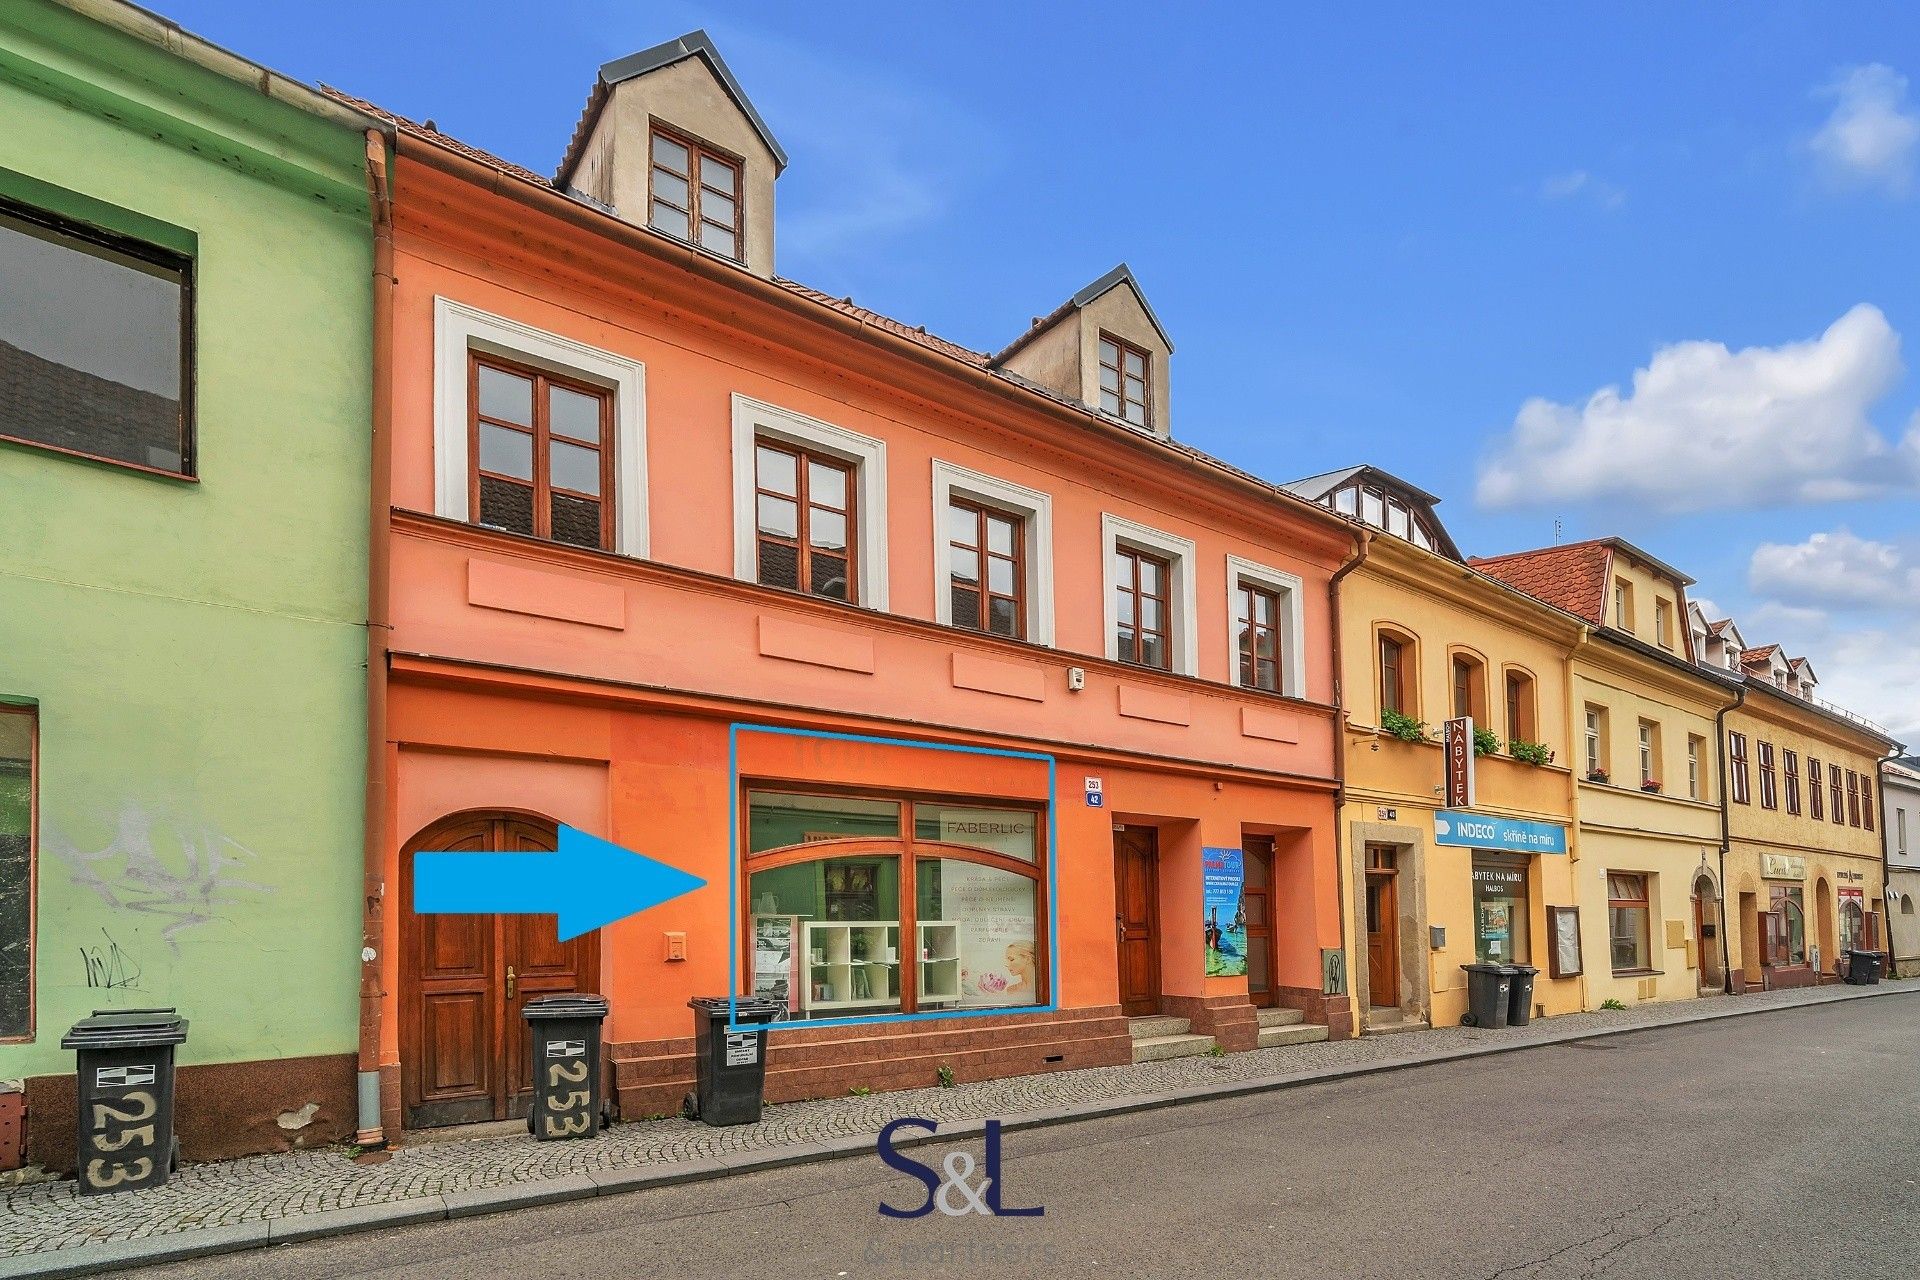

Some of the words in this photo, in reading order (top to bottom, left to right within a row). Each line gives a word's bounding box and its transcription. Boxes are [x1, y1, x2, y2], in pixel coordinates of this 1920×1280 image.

[1453, 720, 1465, 806] NÁBYTEK
[1088, 780, 1099, 790] 253
[1091, 794, 1099, 804] 42
[947, 822, 1025, 834] FABERLIC
[1456, 821, 1495, 840] INDECO
[1528, 832, 1538, 845] na
[1539, 831, 1554, 846] míru
[1496, 872, 1505, 881] NA
[1485, 884, 1504, 893] HALBOS
[546, 1060, 591, 1136] 253
[86, 1091, 157, 1188] 253
